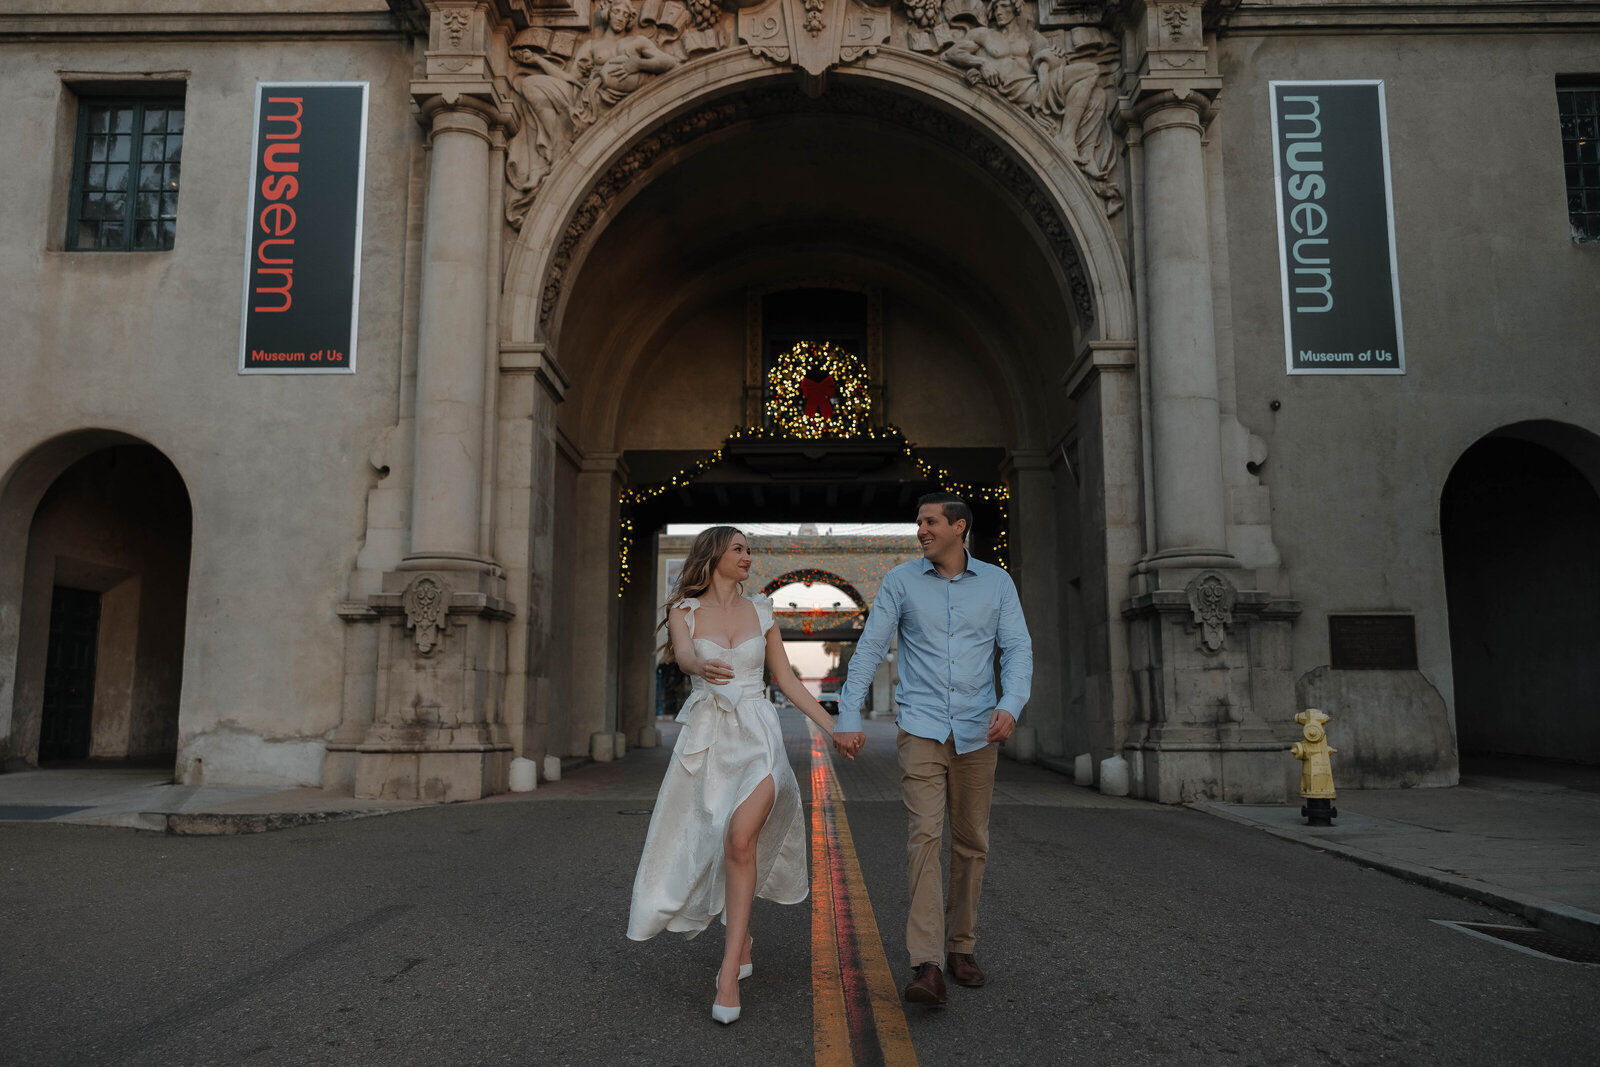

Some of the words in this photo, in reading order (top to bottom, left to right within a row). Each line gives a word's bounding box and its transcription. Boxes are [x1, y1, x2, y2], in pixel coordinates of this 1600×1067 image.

[752, 17, 780, 40] 19
[847, 17, 875, 40] 15
[255, 97, 303, 312] museum
[1283, 96, 1334, 313] museum
[252, 350, 305, 361] Museum
[310, 350, 323, 361] of
[327, 350, 342, 361] Us
[1300, 350, 1354, 362] Museum
[1358, 350, 1371, 361] of
[1375, 350, 1392, 361] Us
